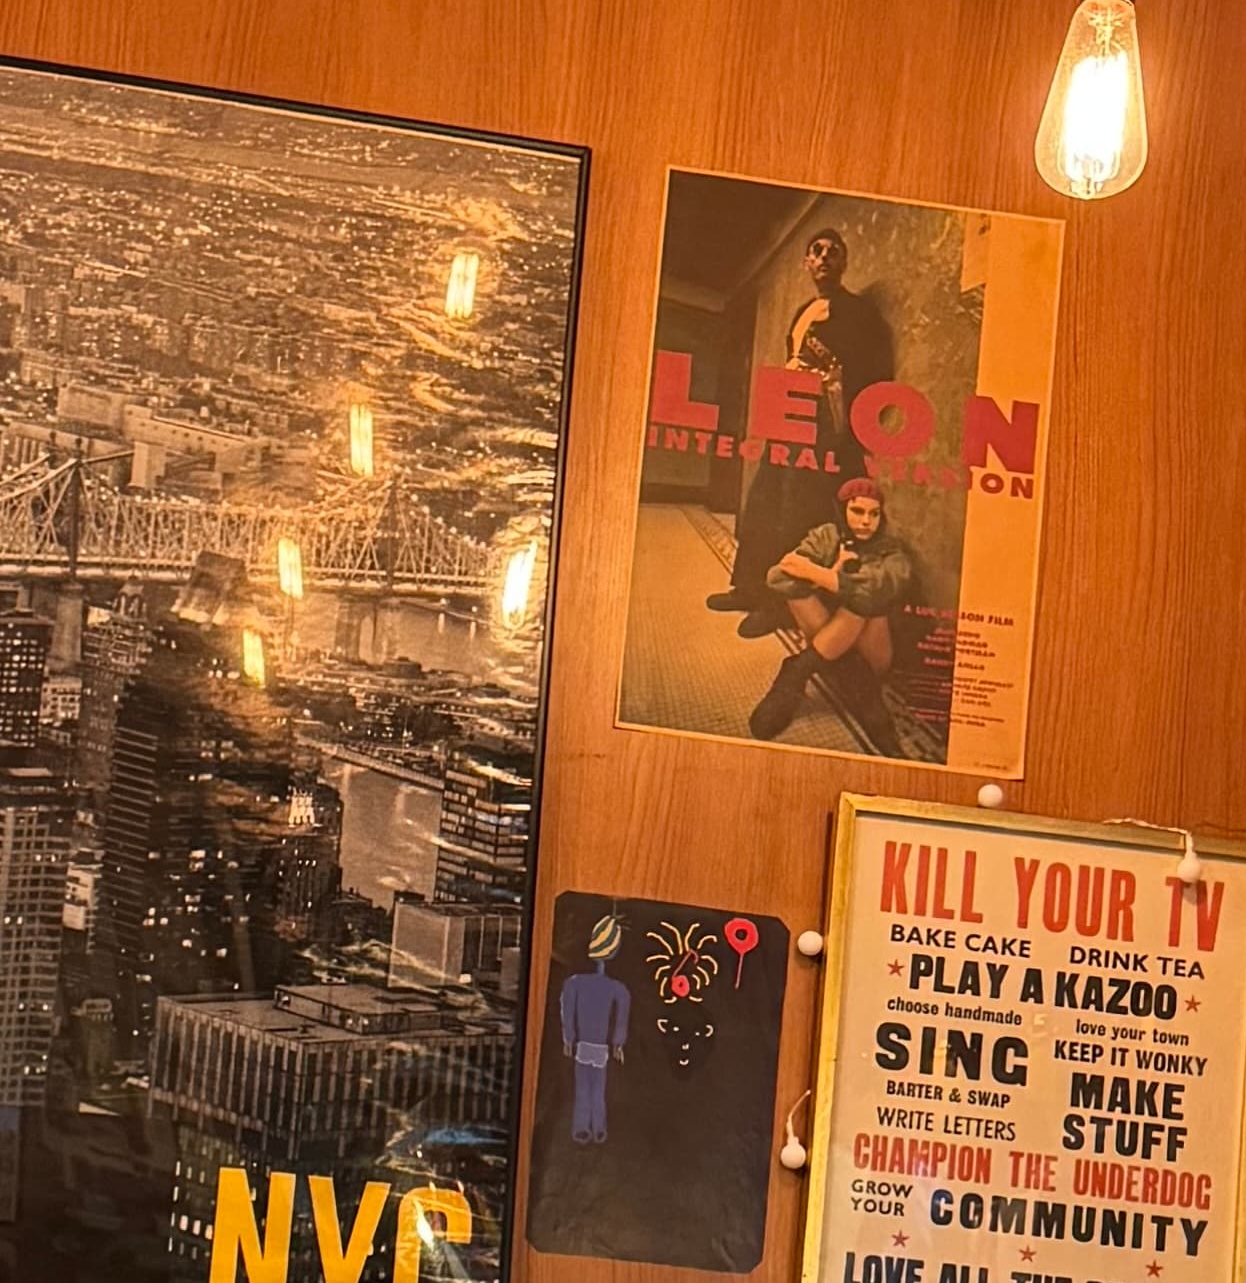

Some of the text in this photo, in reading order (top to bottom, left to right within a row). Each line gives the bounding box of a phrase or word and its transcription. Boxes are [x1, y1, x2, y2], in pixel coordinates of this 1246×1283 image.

[650, 350, 1041, 475] LEON
[647, 426, 1034, 500] INTEGRAL VERSION
[879, 840, 1225, 953] KILL YOUR TV
[890, 923, 1206, 981] BAKE CAKE DRINK TEA
[886, 996, 1023, 1027] choose handmade
[908, 952, 1177, 1021] PLAY A KAZOO
[875, 1021, 1029, 1087] SING
[1054, 1040, 1208, 1078] KEEP IT WONKY
[1075, 1018, 1189, 1047] love your town
[886, 1079, 1011, 1109] BARTER & SWAP
[1069, 1072, 1186, 1121] MAKE
[877, 1106, 1016, 1142] WRITE LETTERS
[1062, 1113, 1188, 1163] STUFF
[851, 1179, 914, 1199] GROW
[853, 1132, 1212, 1211] CHAMPION THE UNDERDOG
[851, 1189, 1209, 1257] YOUR COMMUNITY
